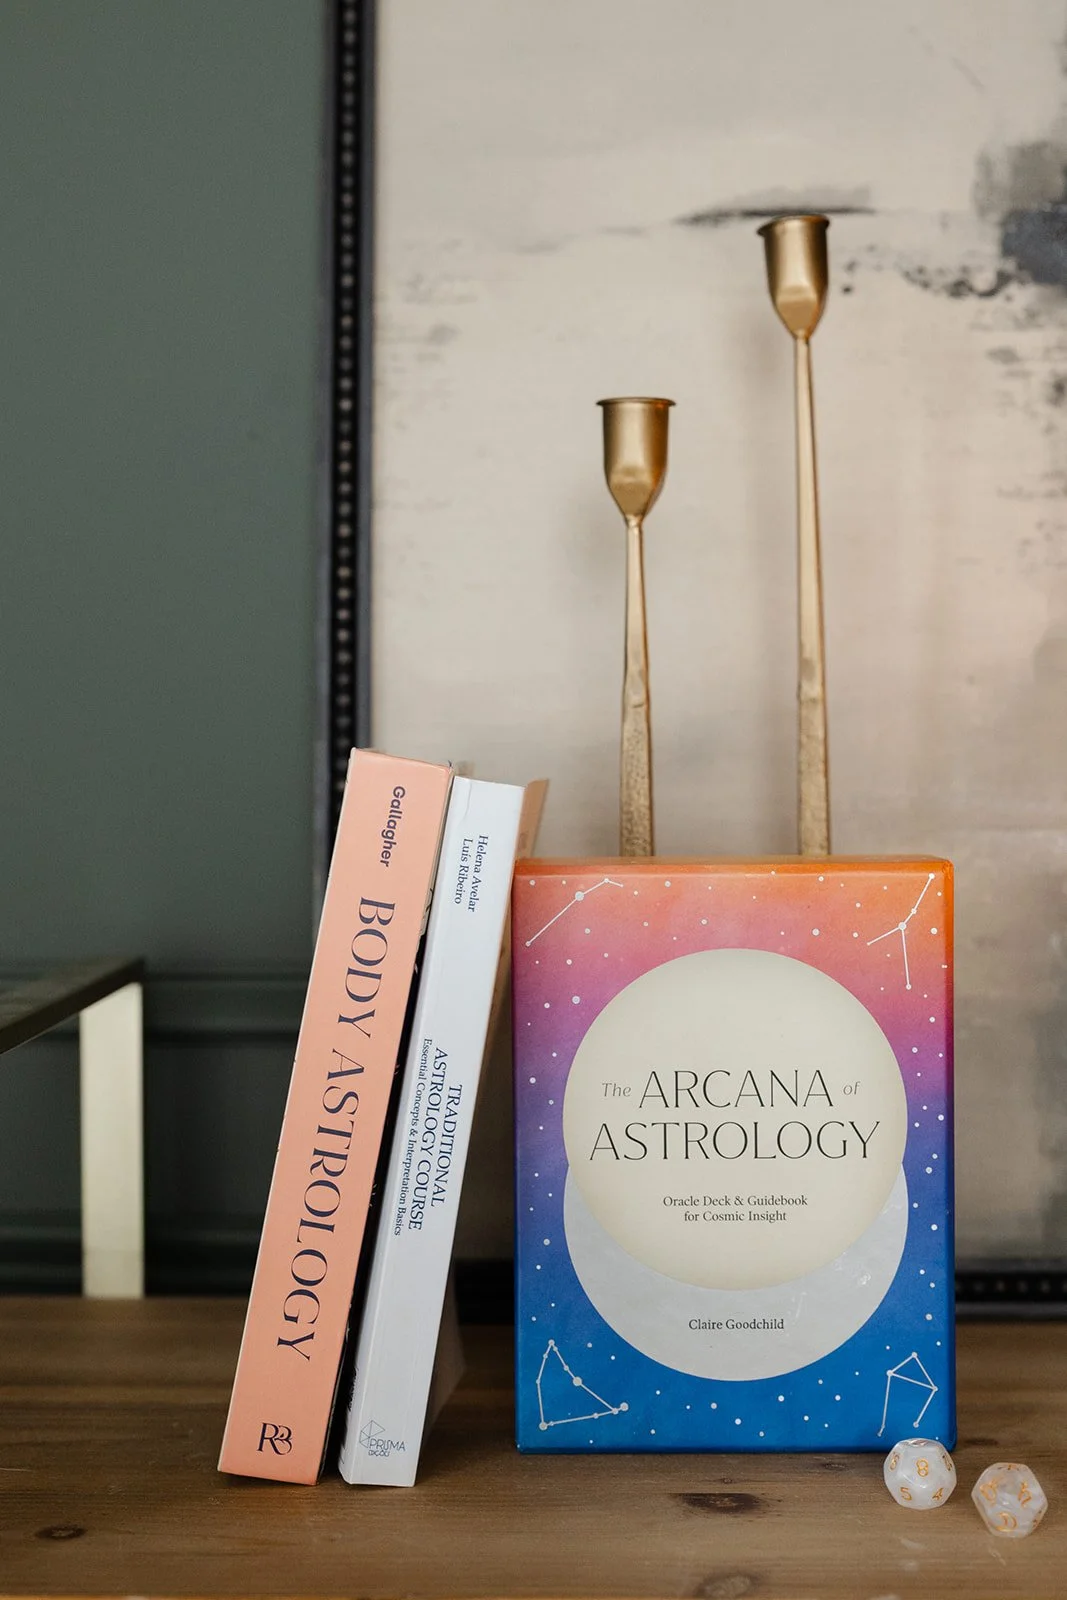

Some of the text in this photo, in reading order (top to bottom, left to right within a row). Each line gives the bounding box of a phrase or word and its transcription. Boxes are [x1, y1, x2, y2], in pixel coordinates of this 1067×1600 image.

[379, 785, 406, 867] Gallagher
[454, 838, 473, 904] Luís Ribeiro
[468, 835, 489, 912] Helena Avelar
[602, 1070, 861, 1109] The ARCANA of
[277, 897, 396, 1361] BODY ASTROLOGY
[394, 1038, 433, 1236] Essential Concepts & Interpretation Basics
[408, 1047, 449, 1230] ASTROLOGY COURSE
[430, 1085, 463, 1207] TRADITIONAL
[589, 1121, 881, 1161] ASTROLOGY
[663, 1194, 808, 1207] Oracle Deck & Guidebook
[684, 1209, 787, 1223] for Cosmic Insight
[688, 1318, 785, 1330] Claire Goodchild
[370, 1438, 406, 1452] PRISMA
[916, 1457, 930, 1478] 8
[900, 1487, 913, 1501] 5
